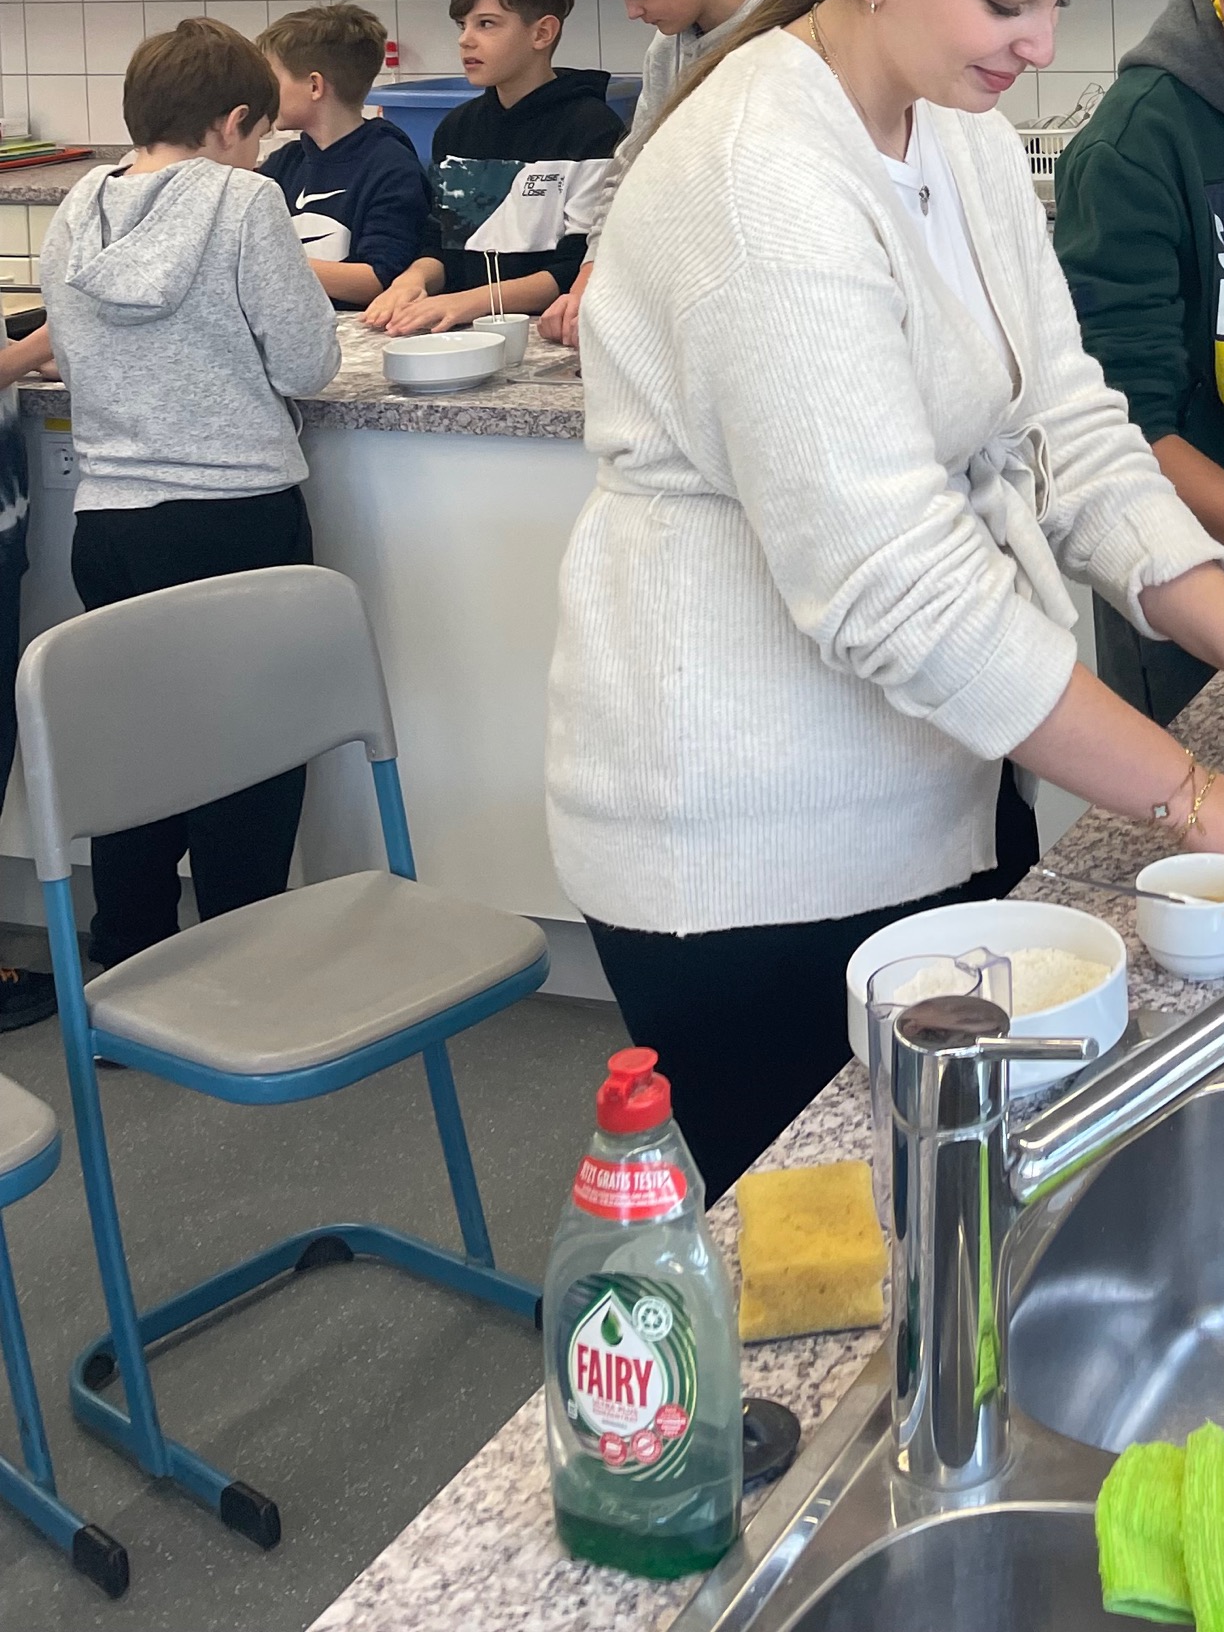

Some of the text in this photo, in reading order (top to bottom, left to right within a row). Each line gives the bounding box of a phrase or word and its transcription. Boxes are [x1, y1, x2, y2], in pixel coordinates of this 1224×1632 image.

[526, 173, 560, 182] REFUSE
[597, 1168, 631, 1191] GRATIS
[576, 1342, 654, 1409] FAIRY
